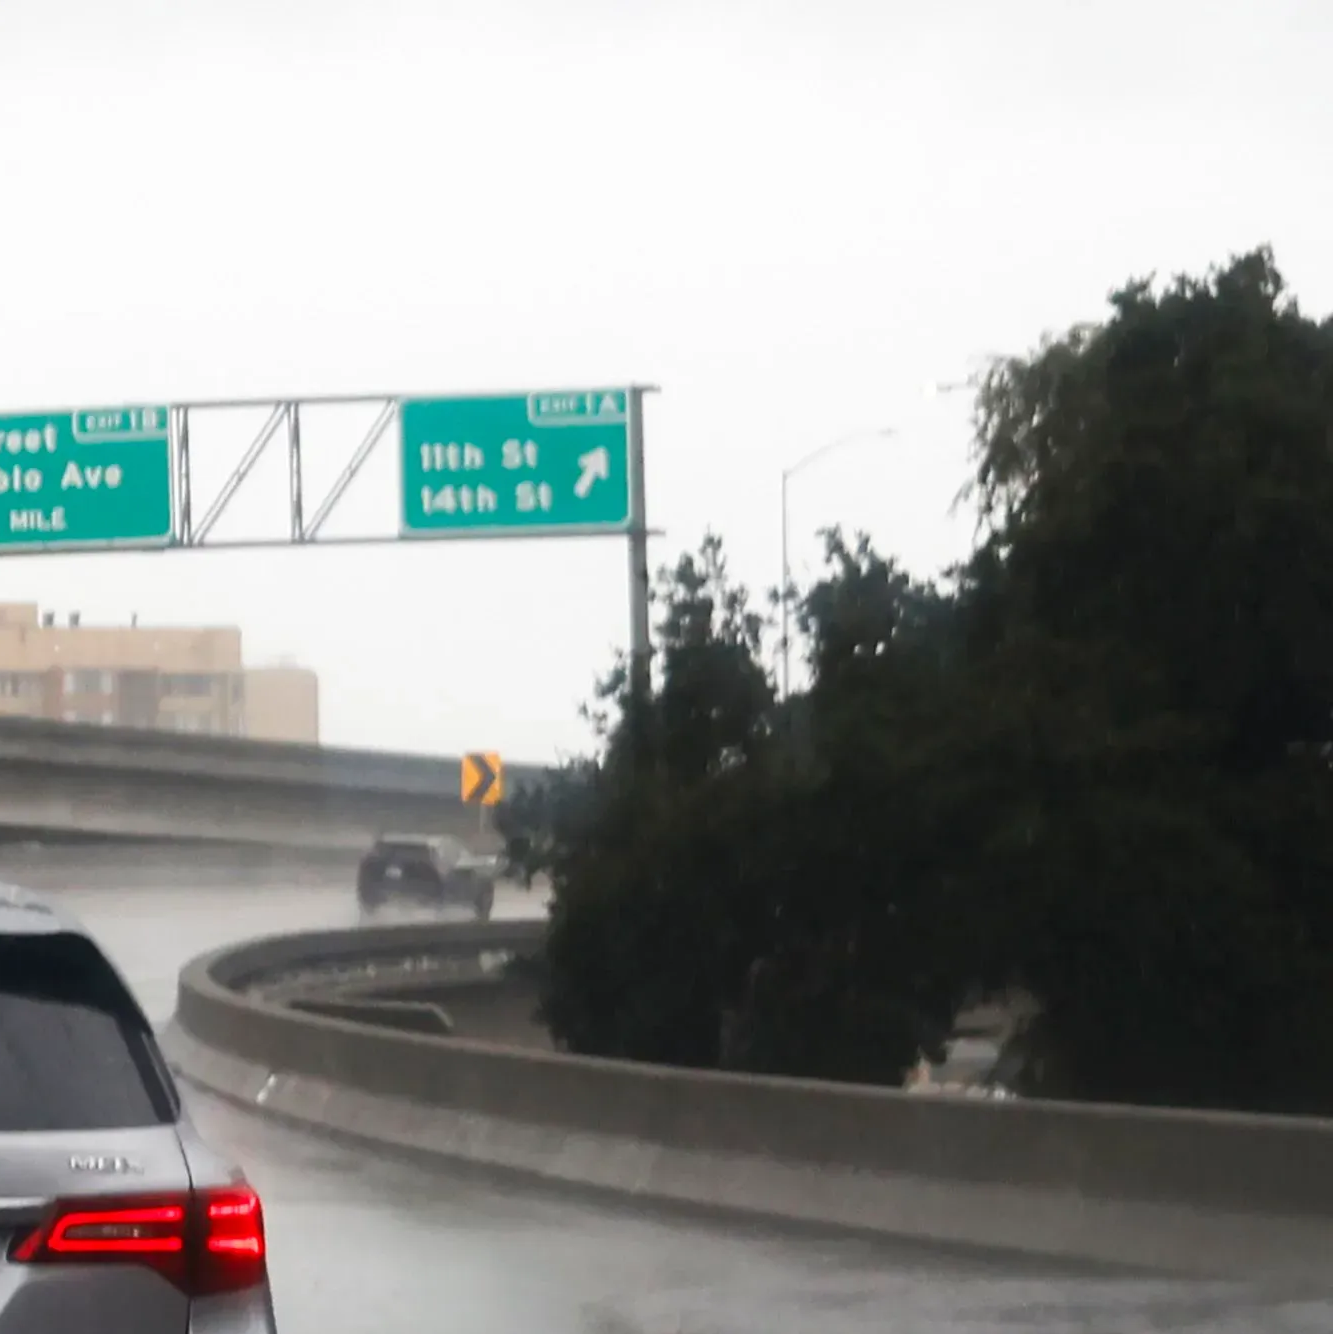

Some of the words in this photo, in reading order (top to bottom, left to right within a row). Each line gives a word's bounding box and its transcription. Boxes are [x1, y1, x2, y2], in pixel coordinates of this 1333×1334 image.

[420, 441, 484, 472] 11th
[501, 438, 538, 469] St
[61, 460, 123, 491] Ave
[420, 483, 498, 516] 14th
[515, 480, 553, 512] St
[9, 506, 68, 533] MILE
